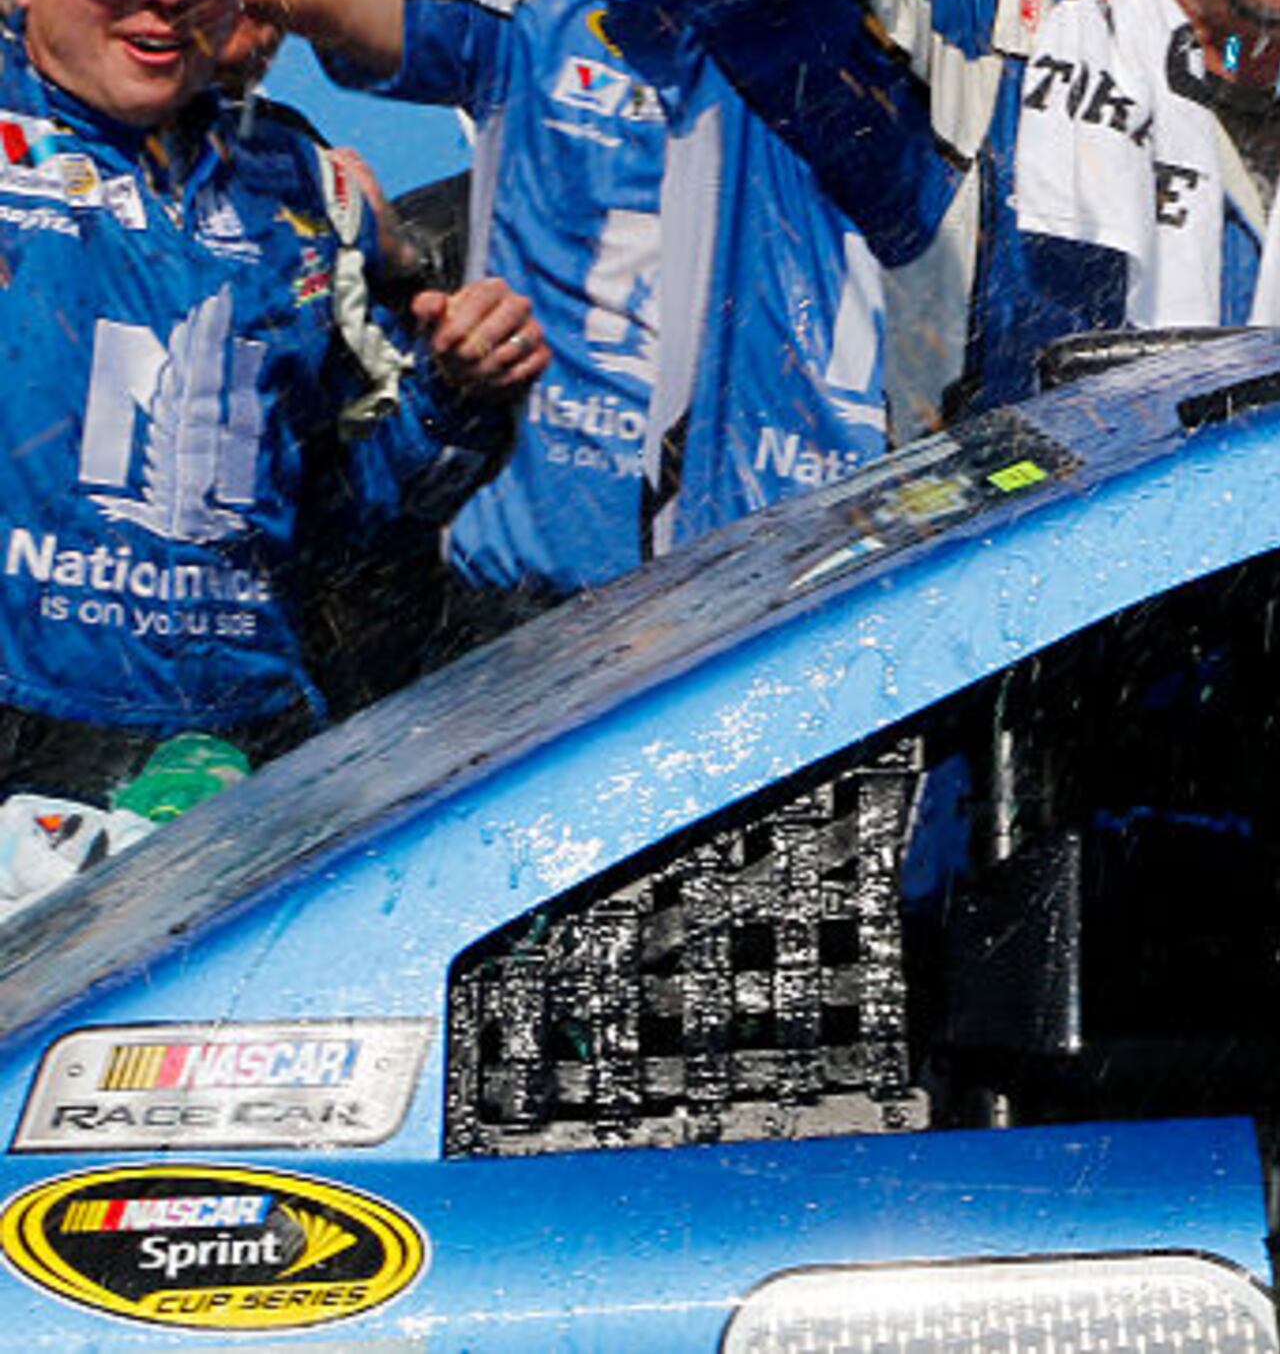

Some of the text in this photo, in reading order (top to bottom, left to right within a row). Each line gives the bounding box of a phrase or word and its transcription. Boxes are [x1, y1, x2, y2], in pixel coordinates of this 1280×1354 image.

[178, 1043, 350, 1087] NASCAR
[49, 1103, 218, 1130] RACE
[122, 1196, 264, 1230] NASCAR
[138, 1228, 285, 1278] Sprint
[154, 1285, 369, 1315] CUP SERIES
